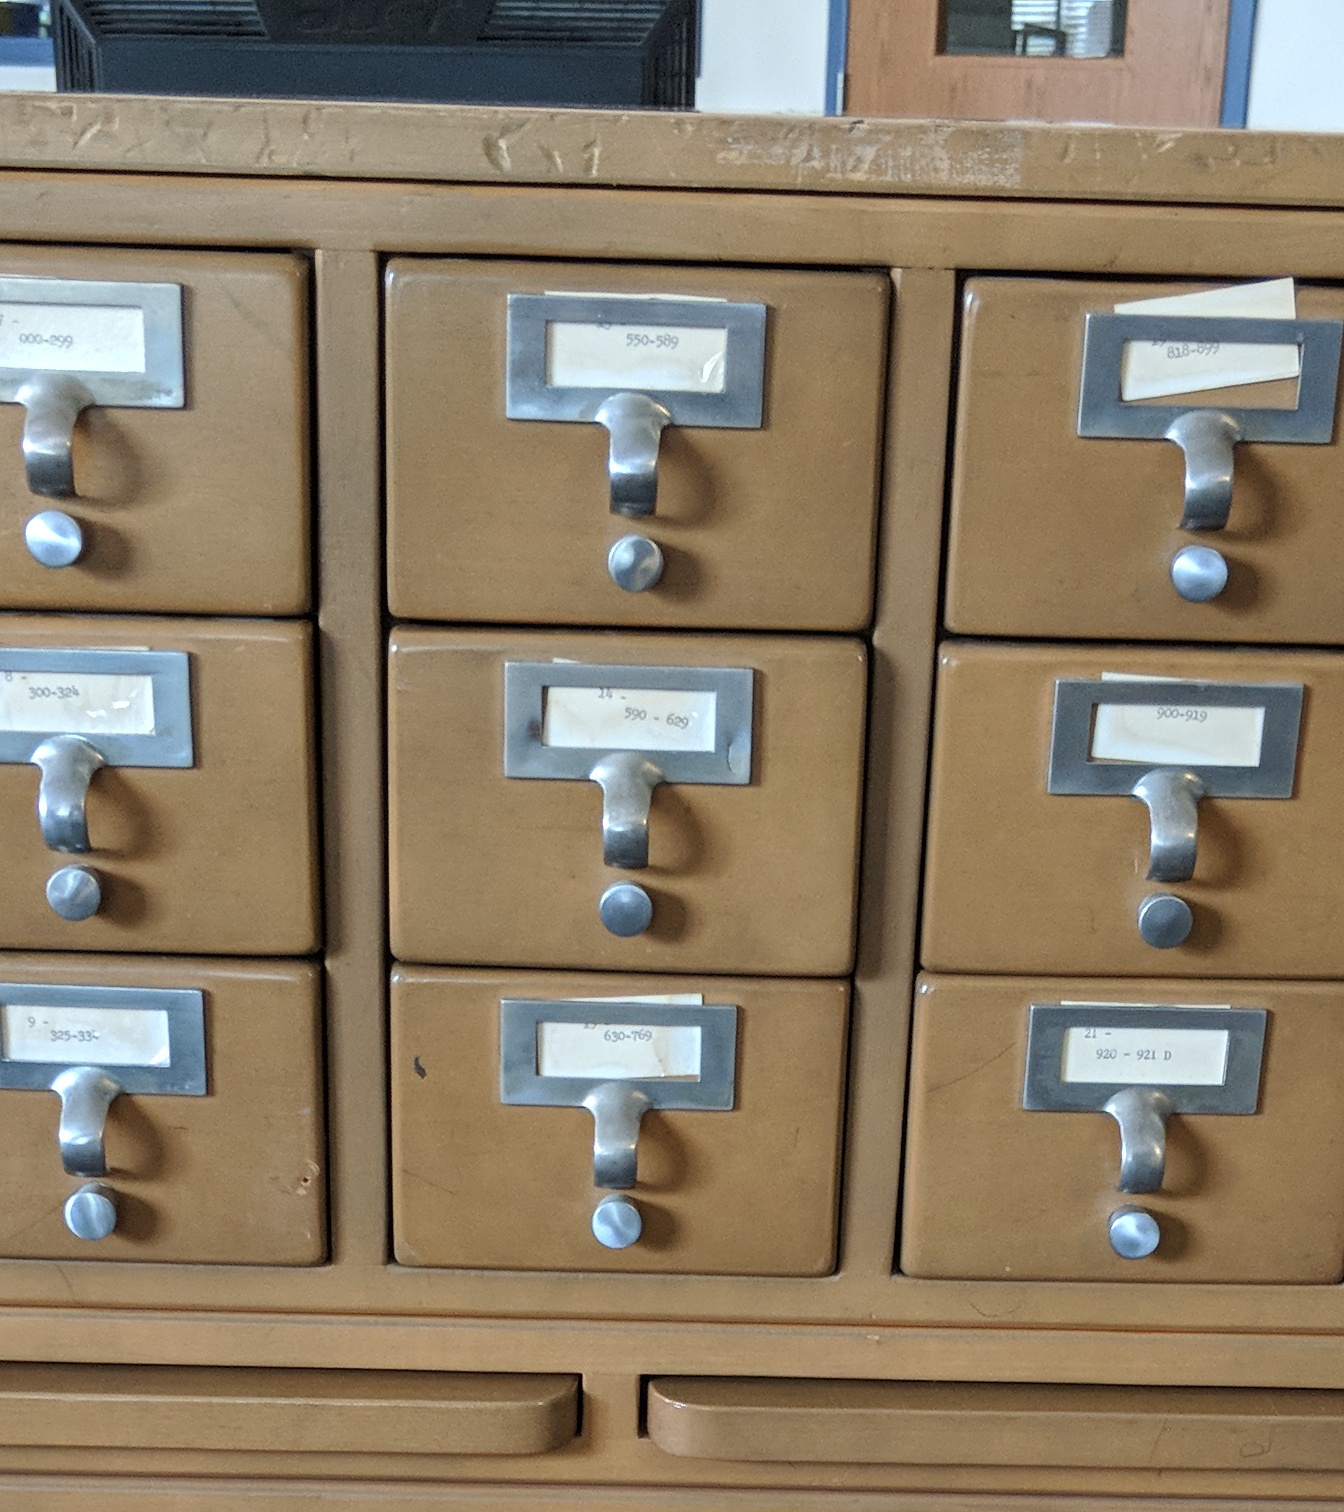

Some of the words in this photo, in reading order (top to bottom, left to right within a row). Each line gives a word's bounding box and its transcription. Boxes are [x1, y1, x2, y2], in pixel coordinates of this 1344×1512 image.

[20, 333, 73, 348] 000-299
[626, 333, 679, 349] 550-589
[1167, 343, 1220, 359] 818-899
[29, 686, 79, 699] 300-324
[598, 688, 613, 699] 14
[625, 707, 647, 721] 590
[666, 713, 689, 729] 629
[1157, 708, 1207, 723] 900-919
[28, 1016, 36, 1028] 9
[604, 1029, 652, 1042] 630-769
[1085, 1029, 1096, 1039] 21
[1096, 1048, 1117, 1060] 920
[1137, 1050, 1156, 1061] 921
[1164, 1051, 1172, 1061] D
